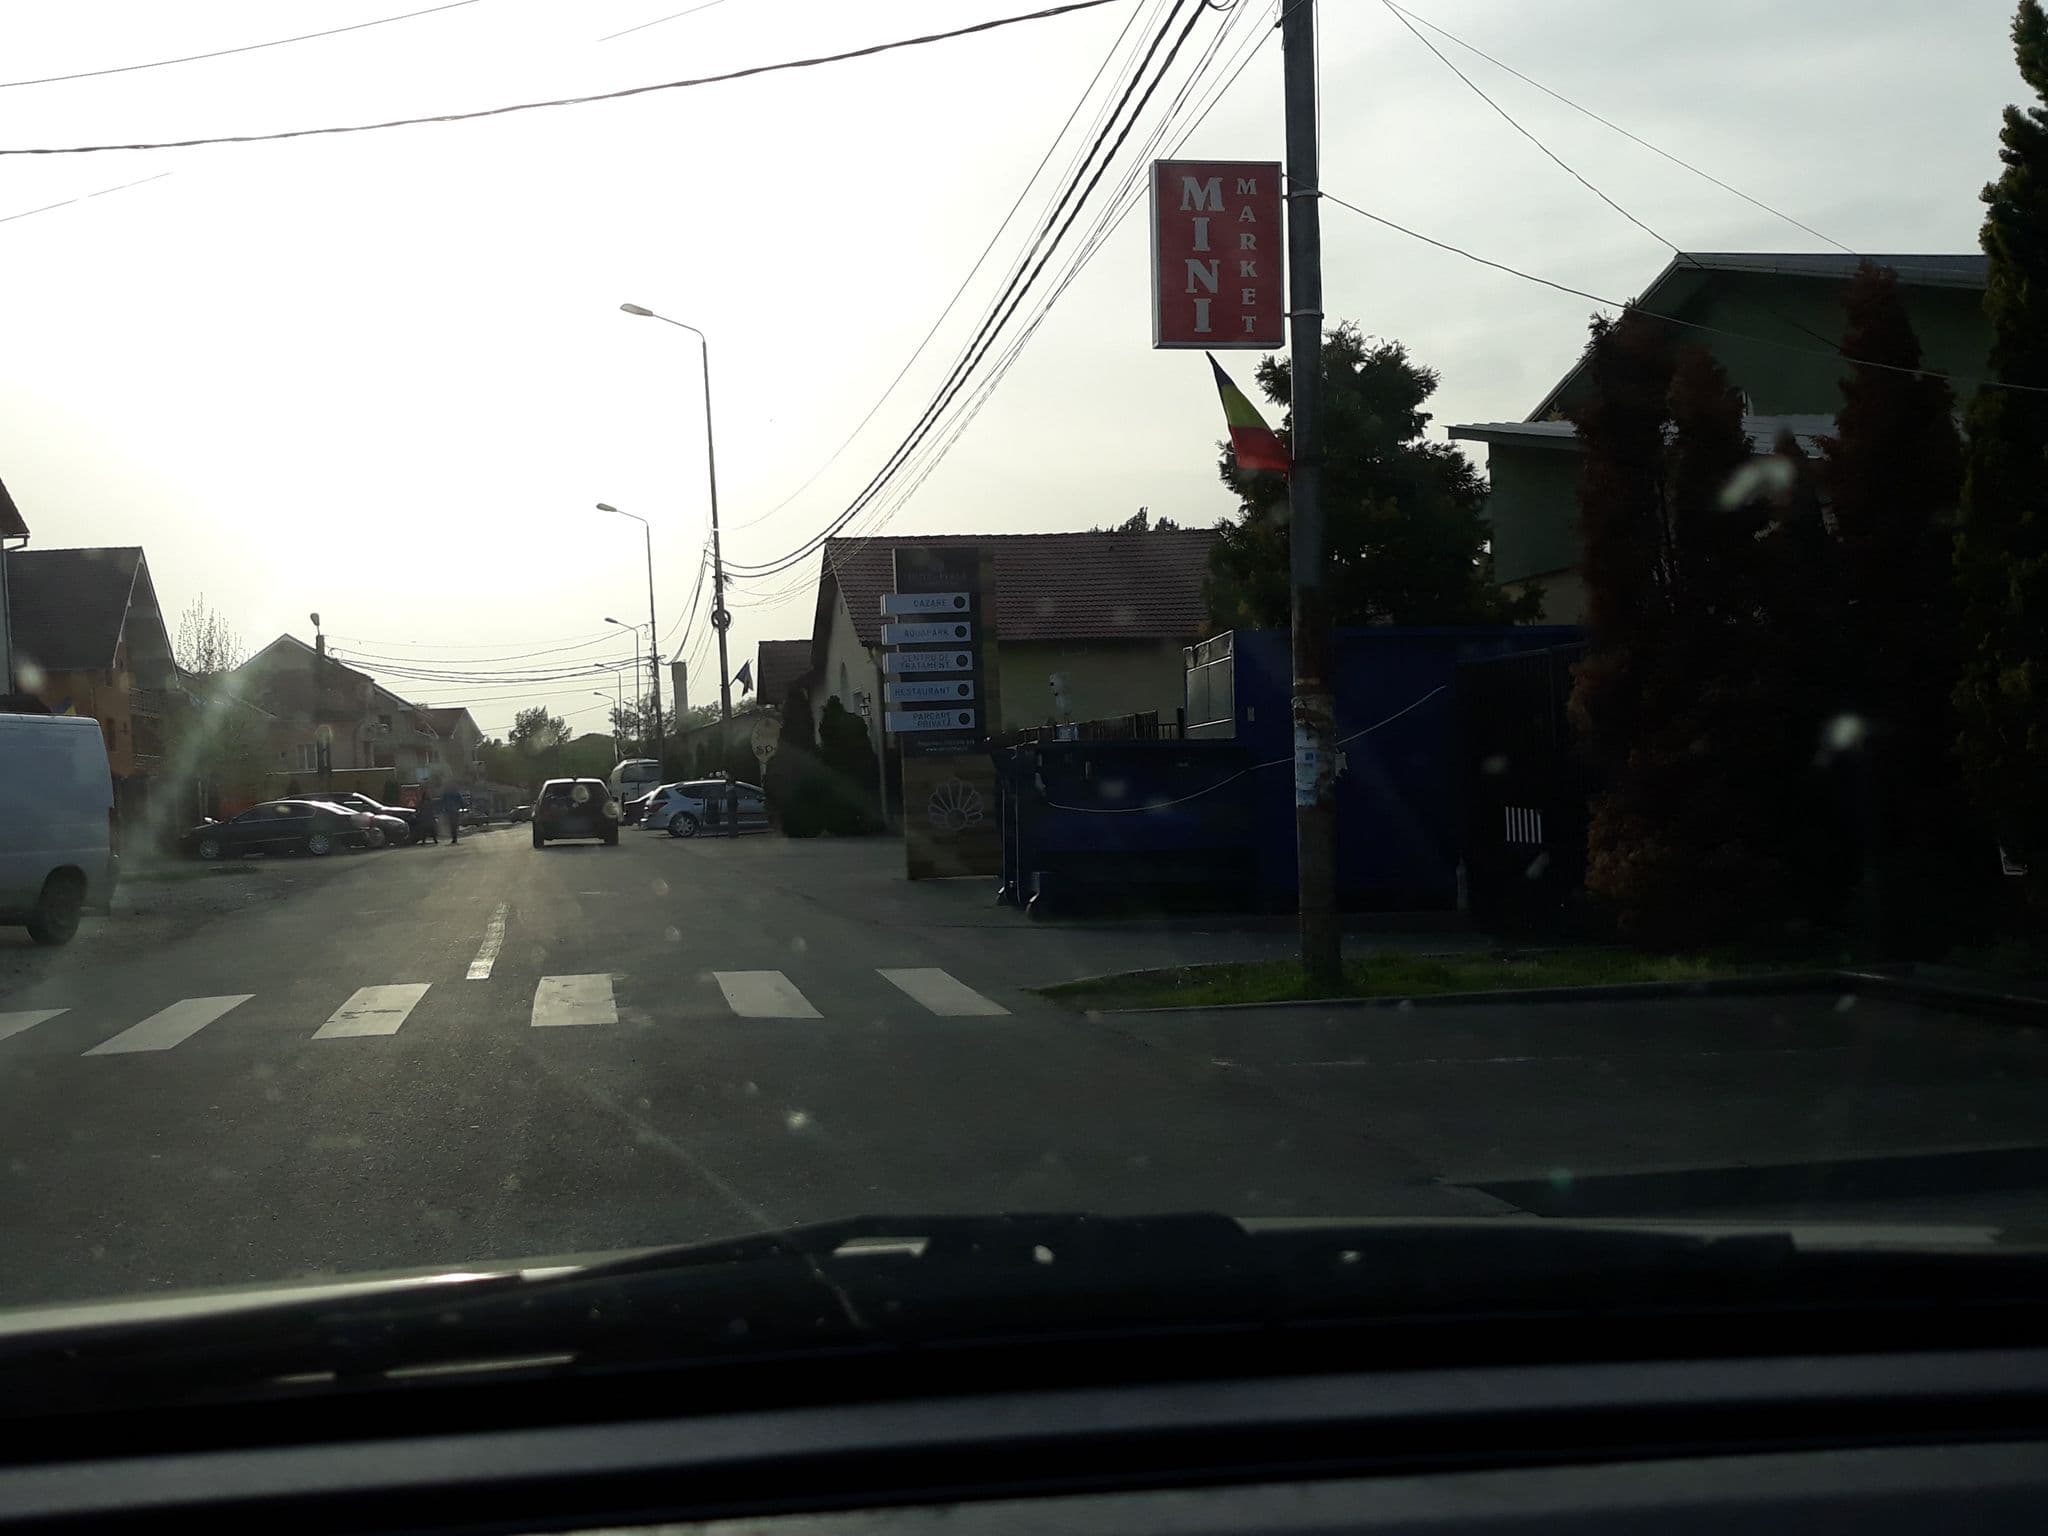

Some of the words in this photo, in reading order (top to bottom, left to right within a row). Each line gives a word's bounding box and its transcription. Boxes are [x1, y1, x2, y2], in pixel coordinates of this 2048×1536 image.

[1179, 176, 1225, 333] MINI
[1236, 178, 1258, 333] MARKET
[913, 599, 947, 608] CAZARE
[904, 628, 949, 638] AQUAPARK
[900, 661, 950, 669] TRATAMENT
[895, 687, 950, 697] RESTAURANT
